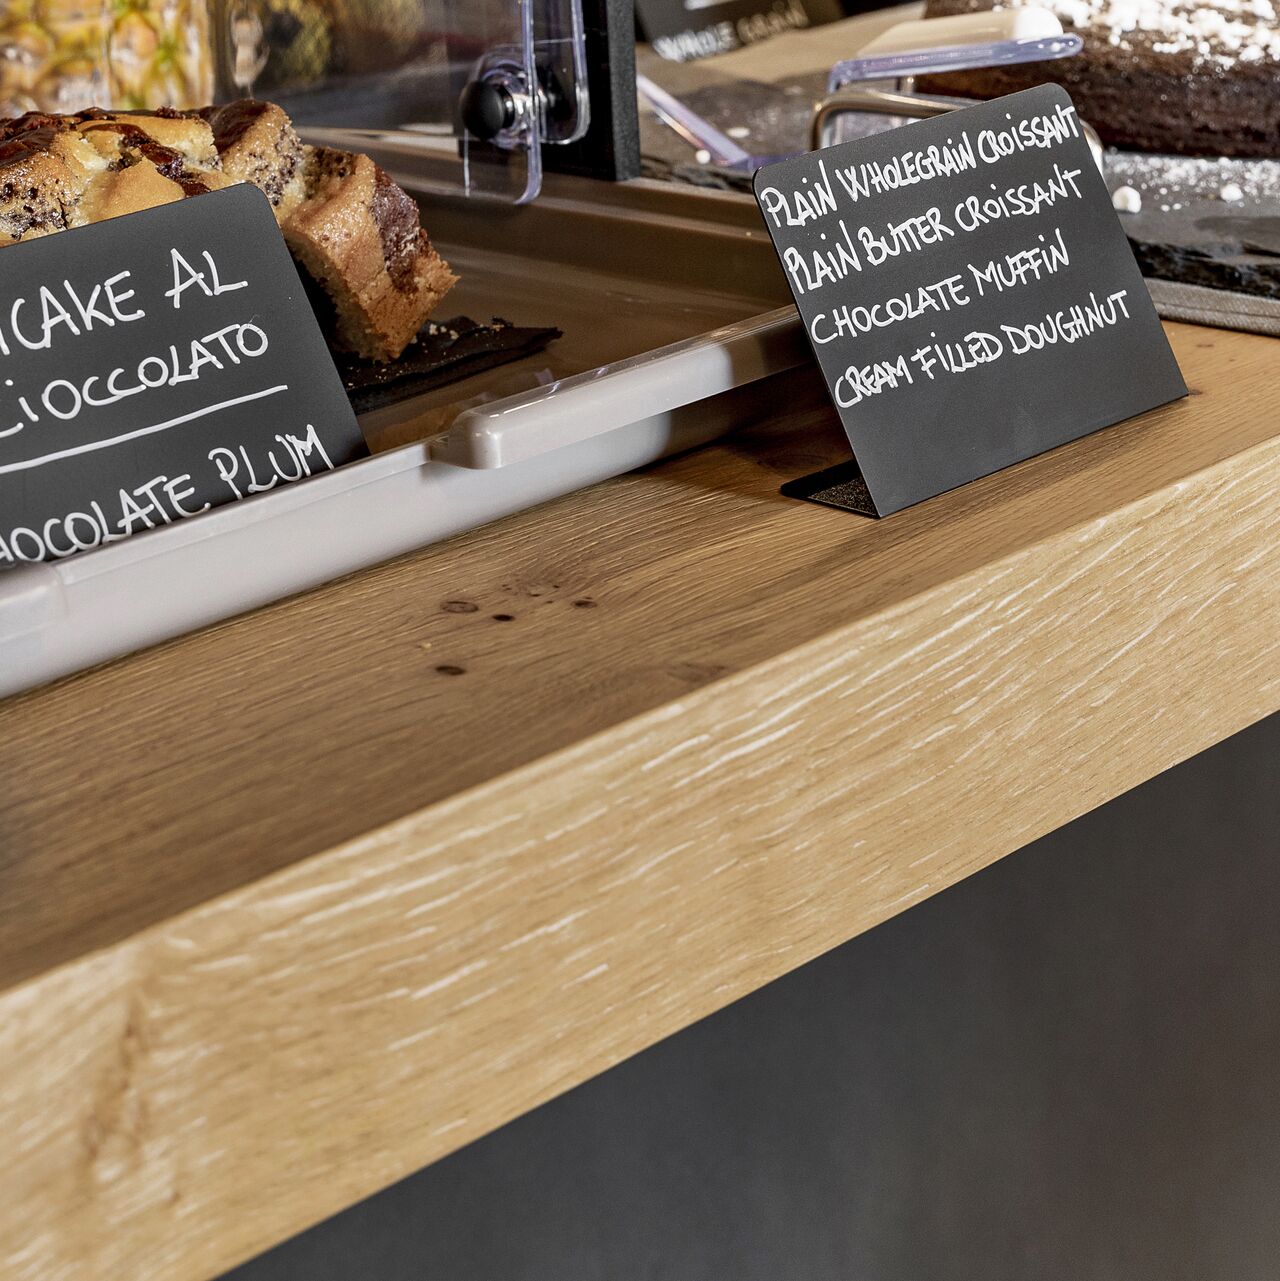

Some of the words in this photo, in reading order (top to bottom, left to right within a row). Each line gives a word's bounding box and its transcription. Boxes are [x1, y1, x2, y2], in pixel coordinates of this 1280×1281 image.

[858, 207, 956, 267] BUTTER
[164, 248, 249, 309] AL
[810, 274, 971, 346] CHOCOLATE
[833, 355, 914, 410] CREAM
[1000, 289, 1131, 355] DOUGHNUT
[208, 423, 334, 501] PLUM
